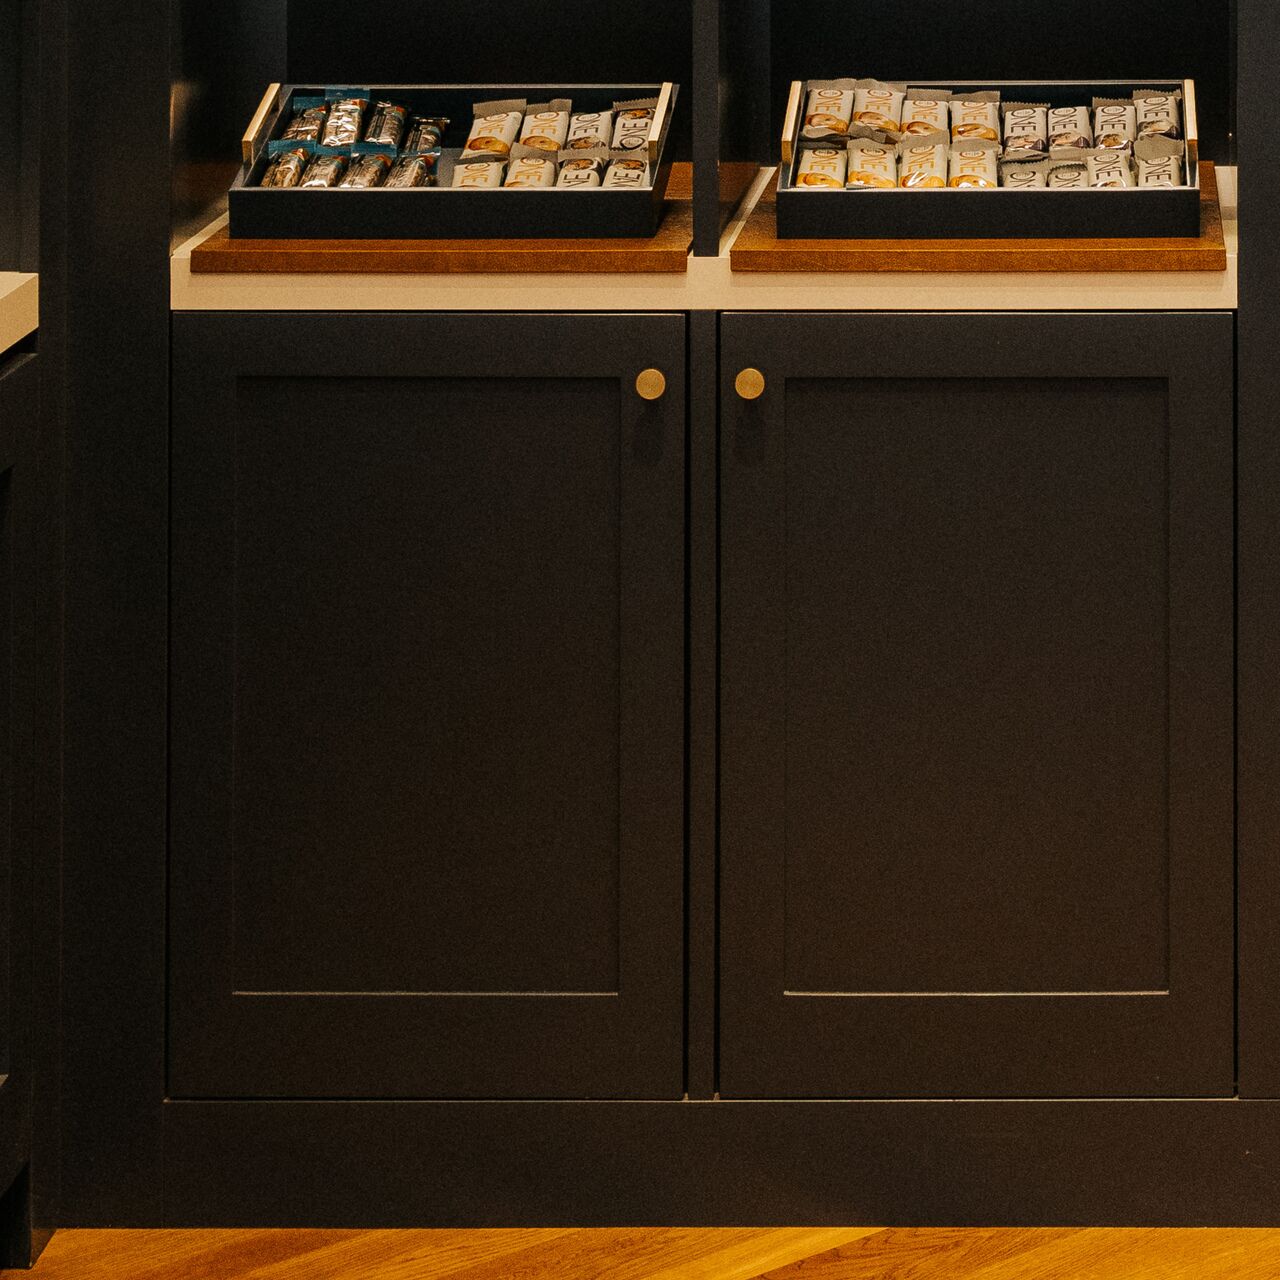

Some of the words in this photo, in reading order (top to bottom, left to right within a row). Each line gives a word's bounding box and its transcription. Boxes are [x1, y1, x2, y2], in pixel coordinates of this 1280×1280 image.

[815, 89, 843, 112] ONE
[865, 89, 893, 112] ONE
[912, 101, 938, 121] ONE
[962, 101, 988, 122] ONE
[1144, 97, 1170, 118] ONE
[530, 111, 559, 135] ONE
[573, 113, 601, 136] ONE
[1011, 108, 1036, 133] ONE
[1052, 107, 1077, 131] ONE
[1101, 106, 1127, 131] ONE
[619, 122, 649, 150] ONE
[515, 157, 547, 182] ONE
[810, 148, 839, 172] ONE
[860, 148, 888, 172] ONE
[960, 151, 986, 173] ONE
[1094, 154, 1123, 180] ONE
[1145, 156, 1171, 183] ONE
[563, 173, 591, 187] NE
[611, 172, 640, 187] NE
[1010, 171, 1036, 187] ON
[1055, 172, 1081, 187] ON
